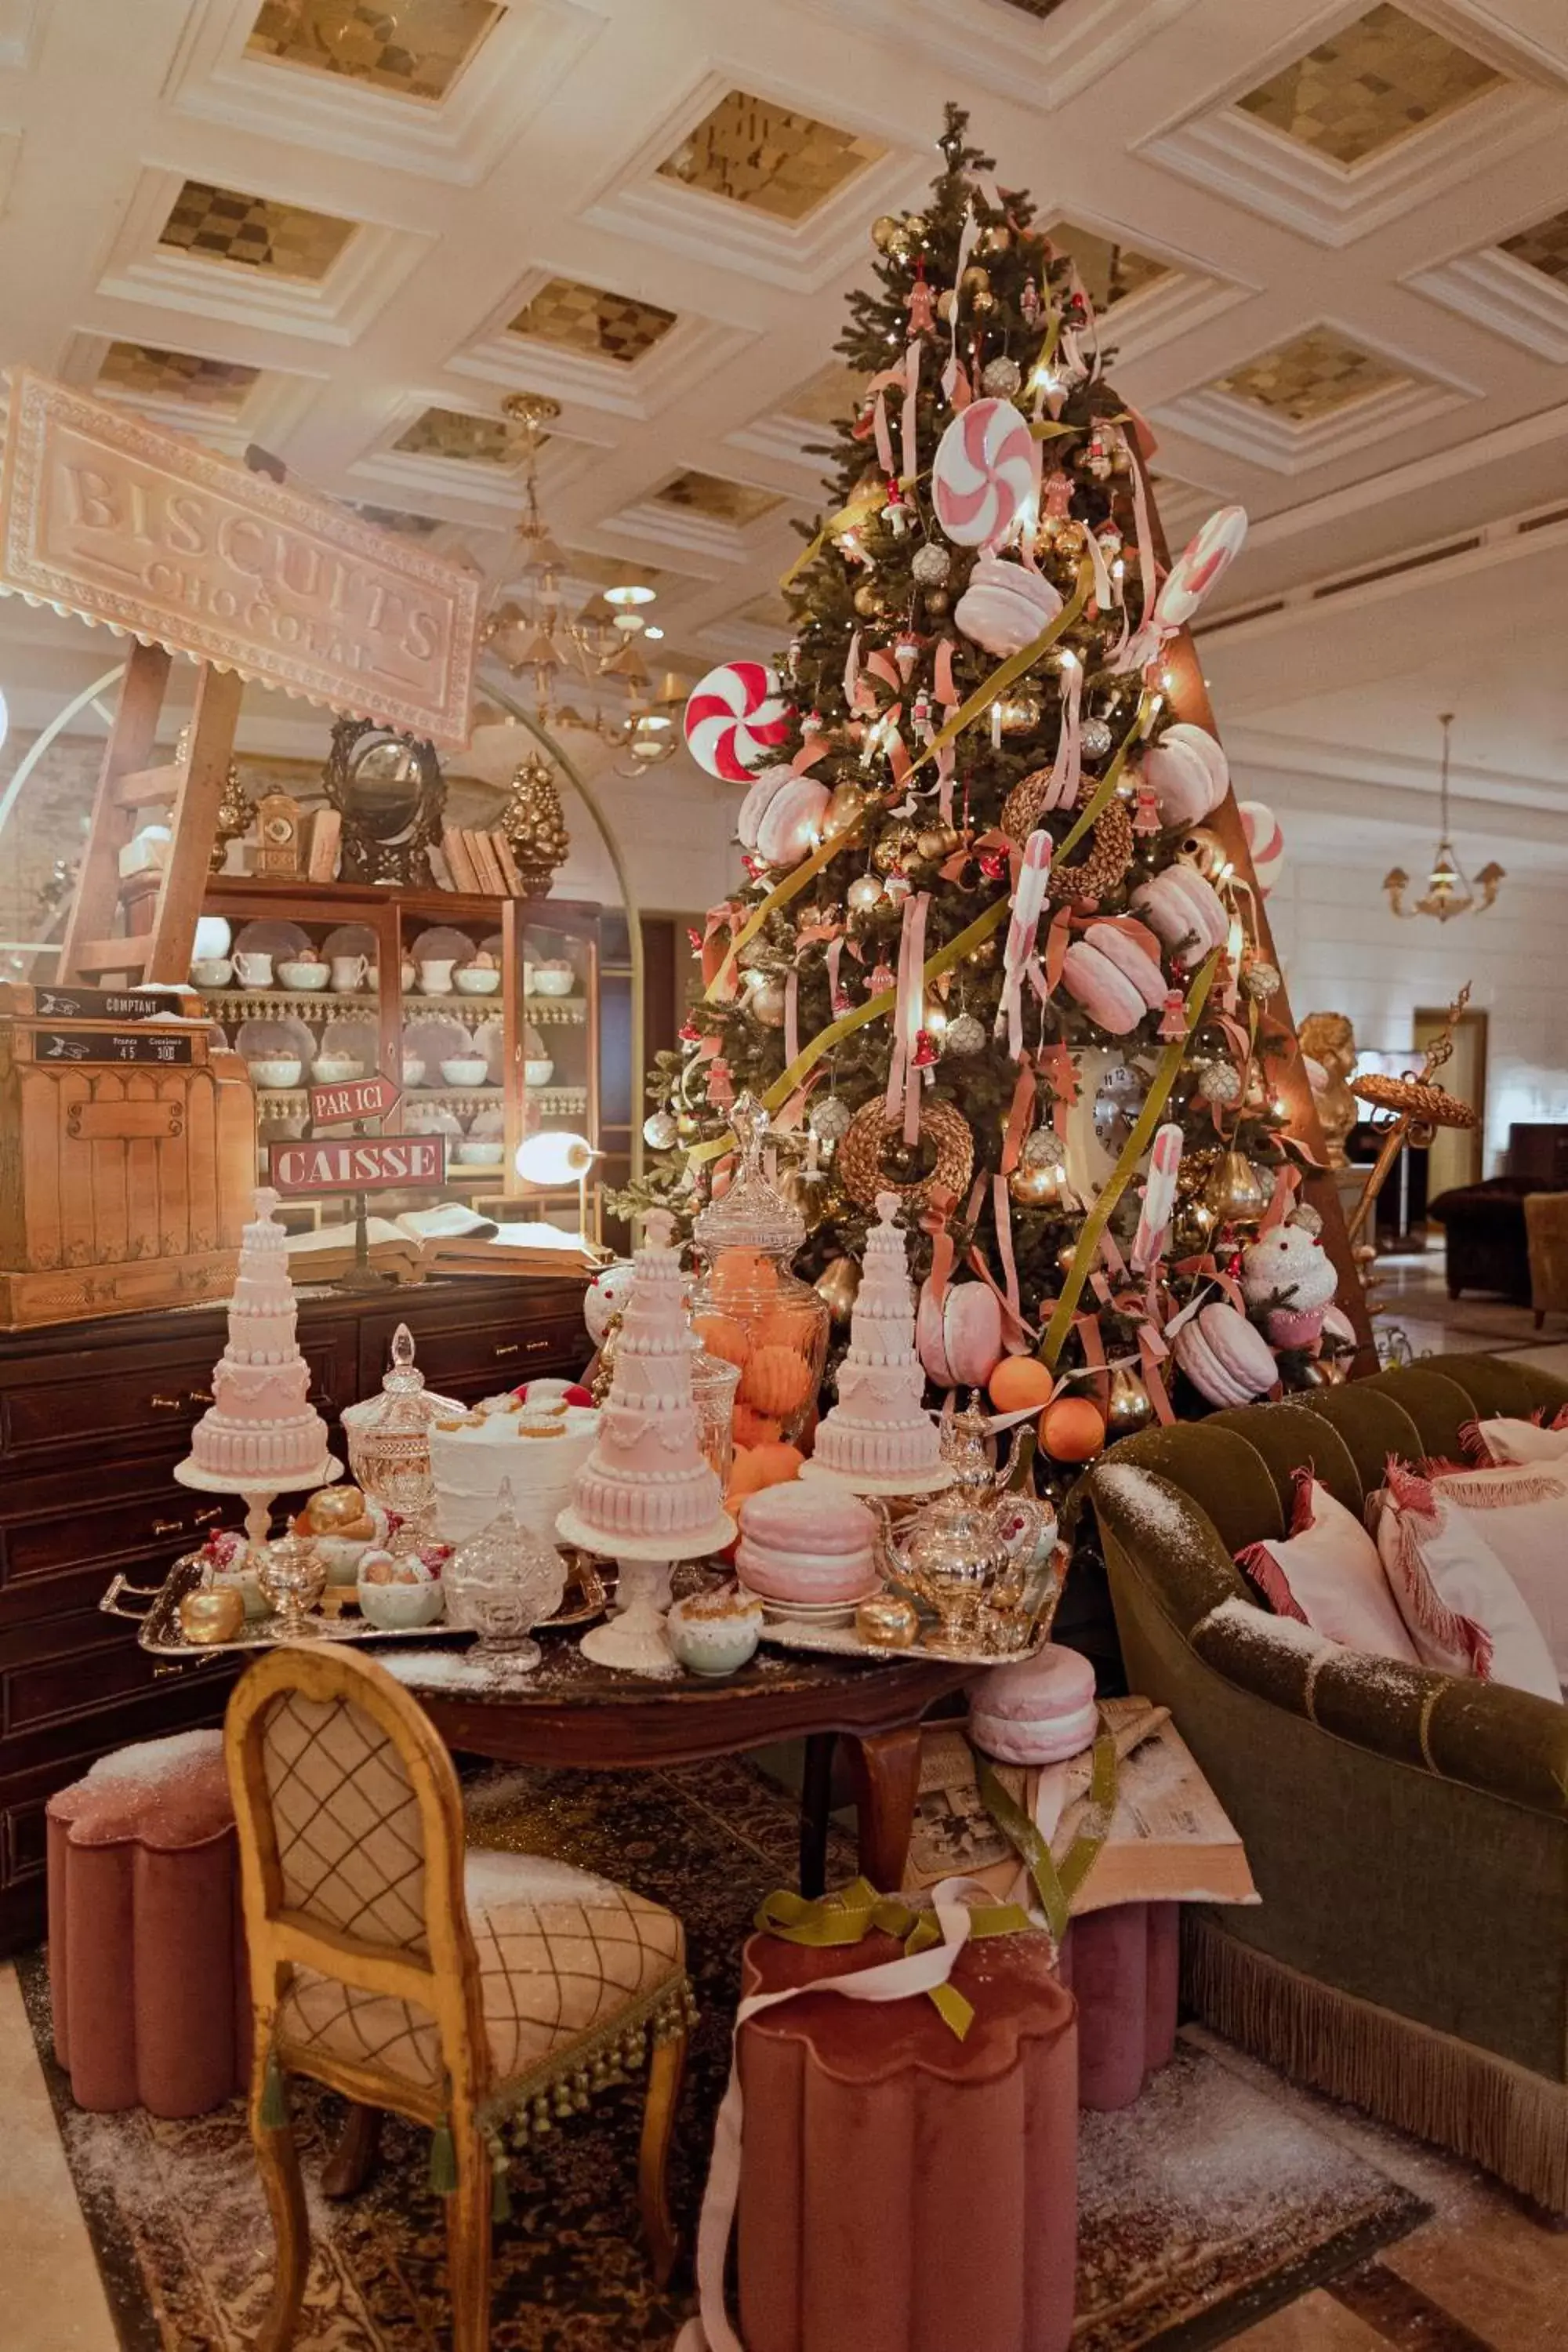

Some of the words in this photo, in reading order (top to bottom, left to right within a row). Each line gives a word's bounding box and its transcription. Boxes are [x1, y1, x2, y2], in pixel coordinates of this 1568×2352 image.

[61, 464, 441, 661] BISCUITS
[140, 561, 372, 670] CHOCOLAT
[106, 997, 157, 1013] COMPTANT
[1104, 1073, 1112, 1086] 11
[1116, 1069, 1125, 1081] 12
[314, 1091, 352, 1117] PAR
[354, 1086, 383, 1111] ICI
[1104, 1138, 1111, 1151] 7
[278, 1145, 436, 1185] CAISSE
